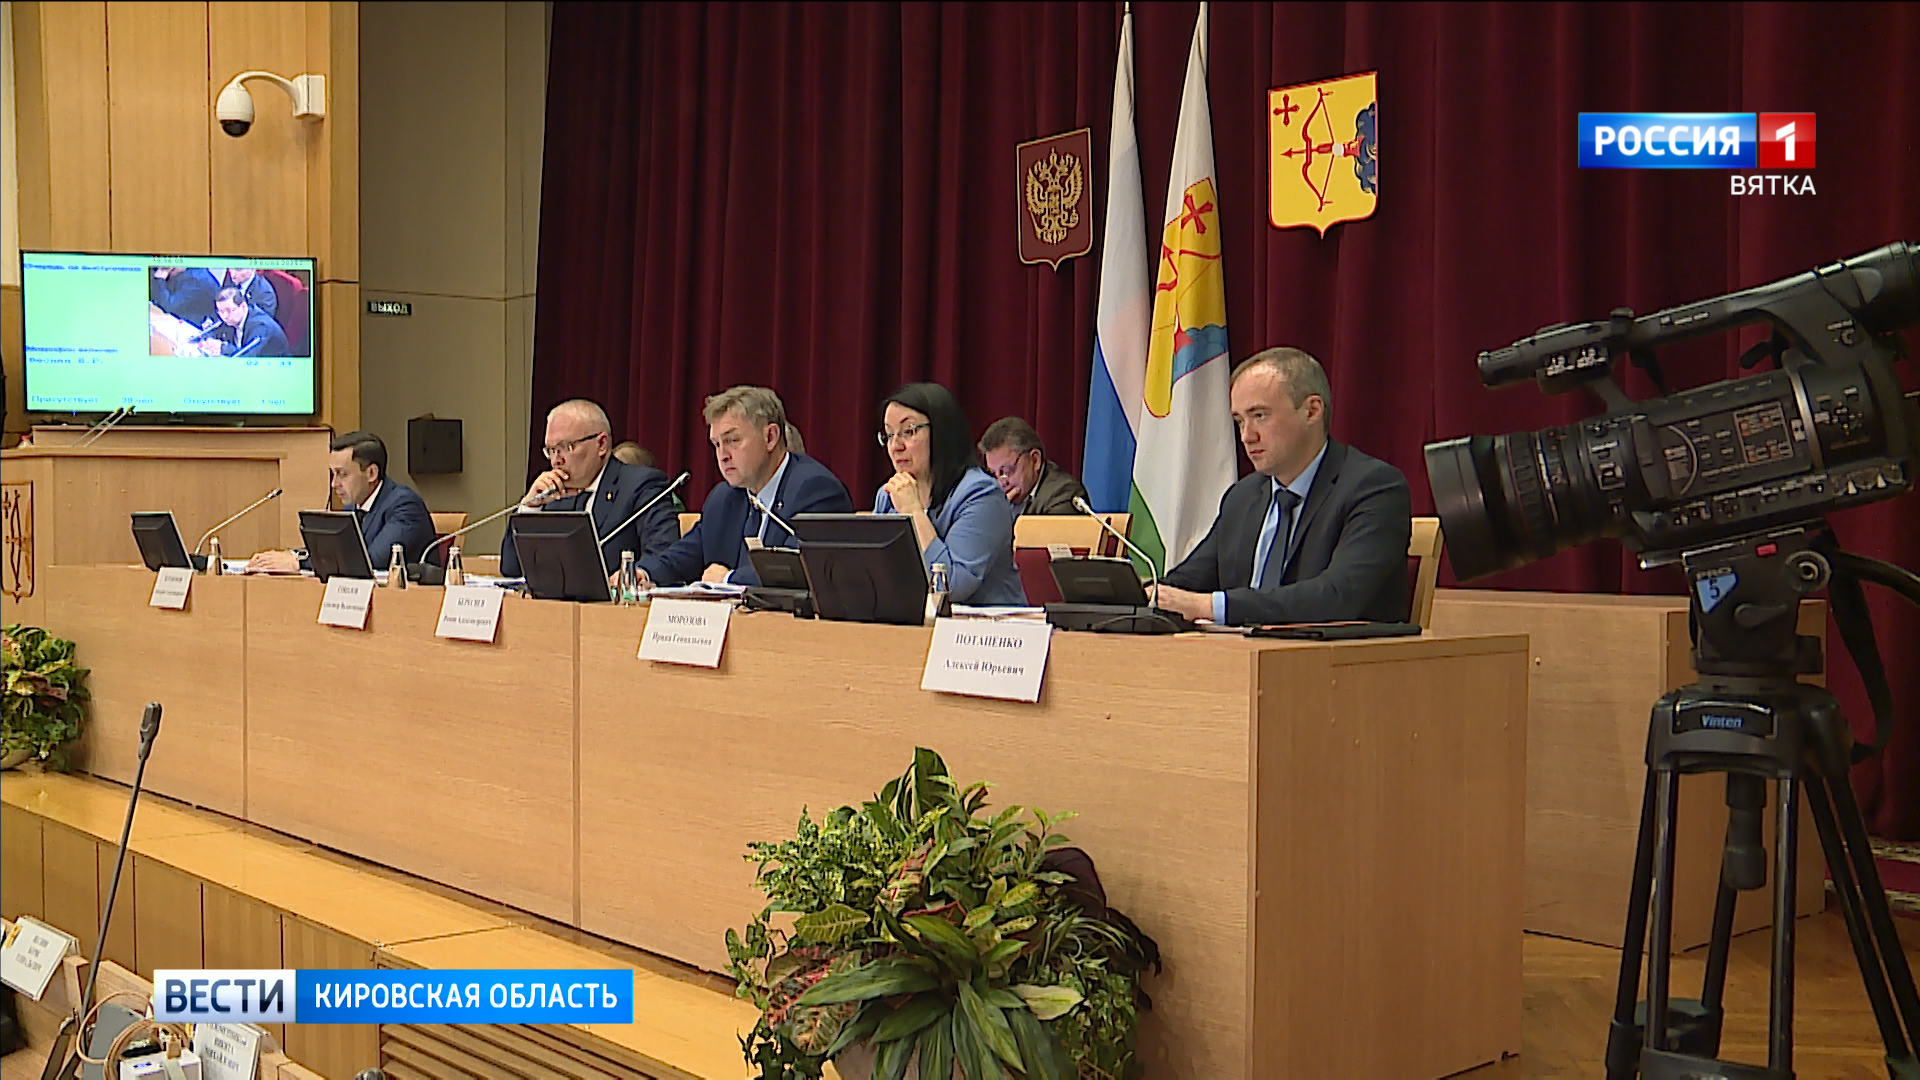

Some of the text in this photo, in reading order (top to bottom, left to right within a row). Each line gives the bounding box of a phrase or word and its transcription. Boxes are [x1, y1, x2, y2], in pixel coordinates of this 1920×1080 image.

[371, 301, 408, 314] ВЫХОД
[1709, 578, 1720, 599] 5
[955, 633, 1023, 648] ПОТАПЕНКО
[943, 659, 1024, 675] Алексей Юрьевич
[1702, 713, 1743, 728] Vinten
